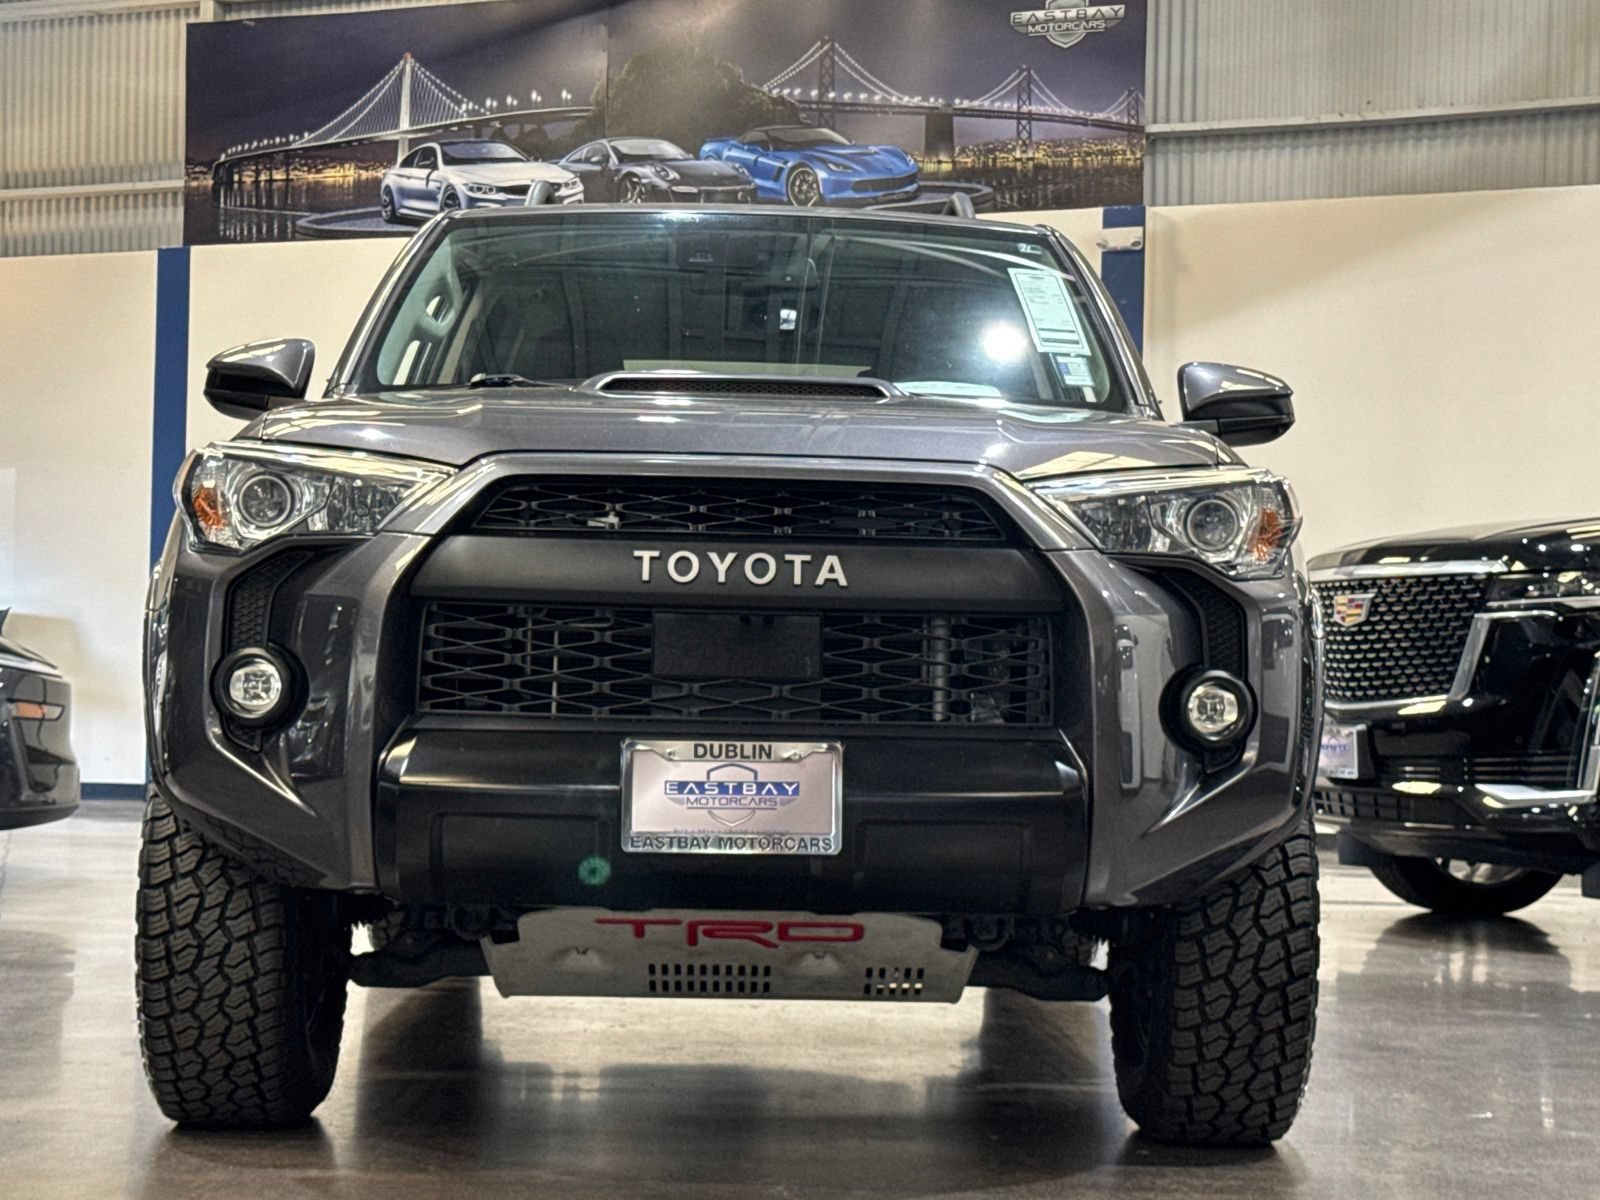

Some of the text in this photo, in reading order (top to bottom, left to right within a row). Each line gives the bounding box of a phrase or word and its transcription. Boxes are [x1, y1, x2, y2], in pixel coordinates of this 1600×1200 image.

[1012, 6, 1123, 25] EASTBAY
[1027, 20, 1106, 33] MOTORCARS
[632, 550, 849, 587] TOYOTA
[693, 743, 773, 760] DUBLIN
[665, 782, 799, 795] EASTBAY
[686, 796, 778, 807] MOTORCARS
[630, 836, 833, 851] EASTBAY MOTORCARS
[594, 918, 865, 949] TRD
